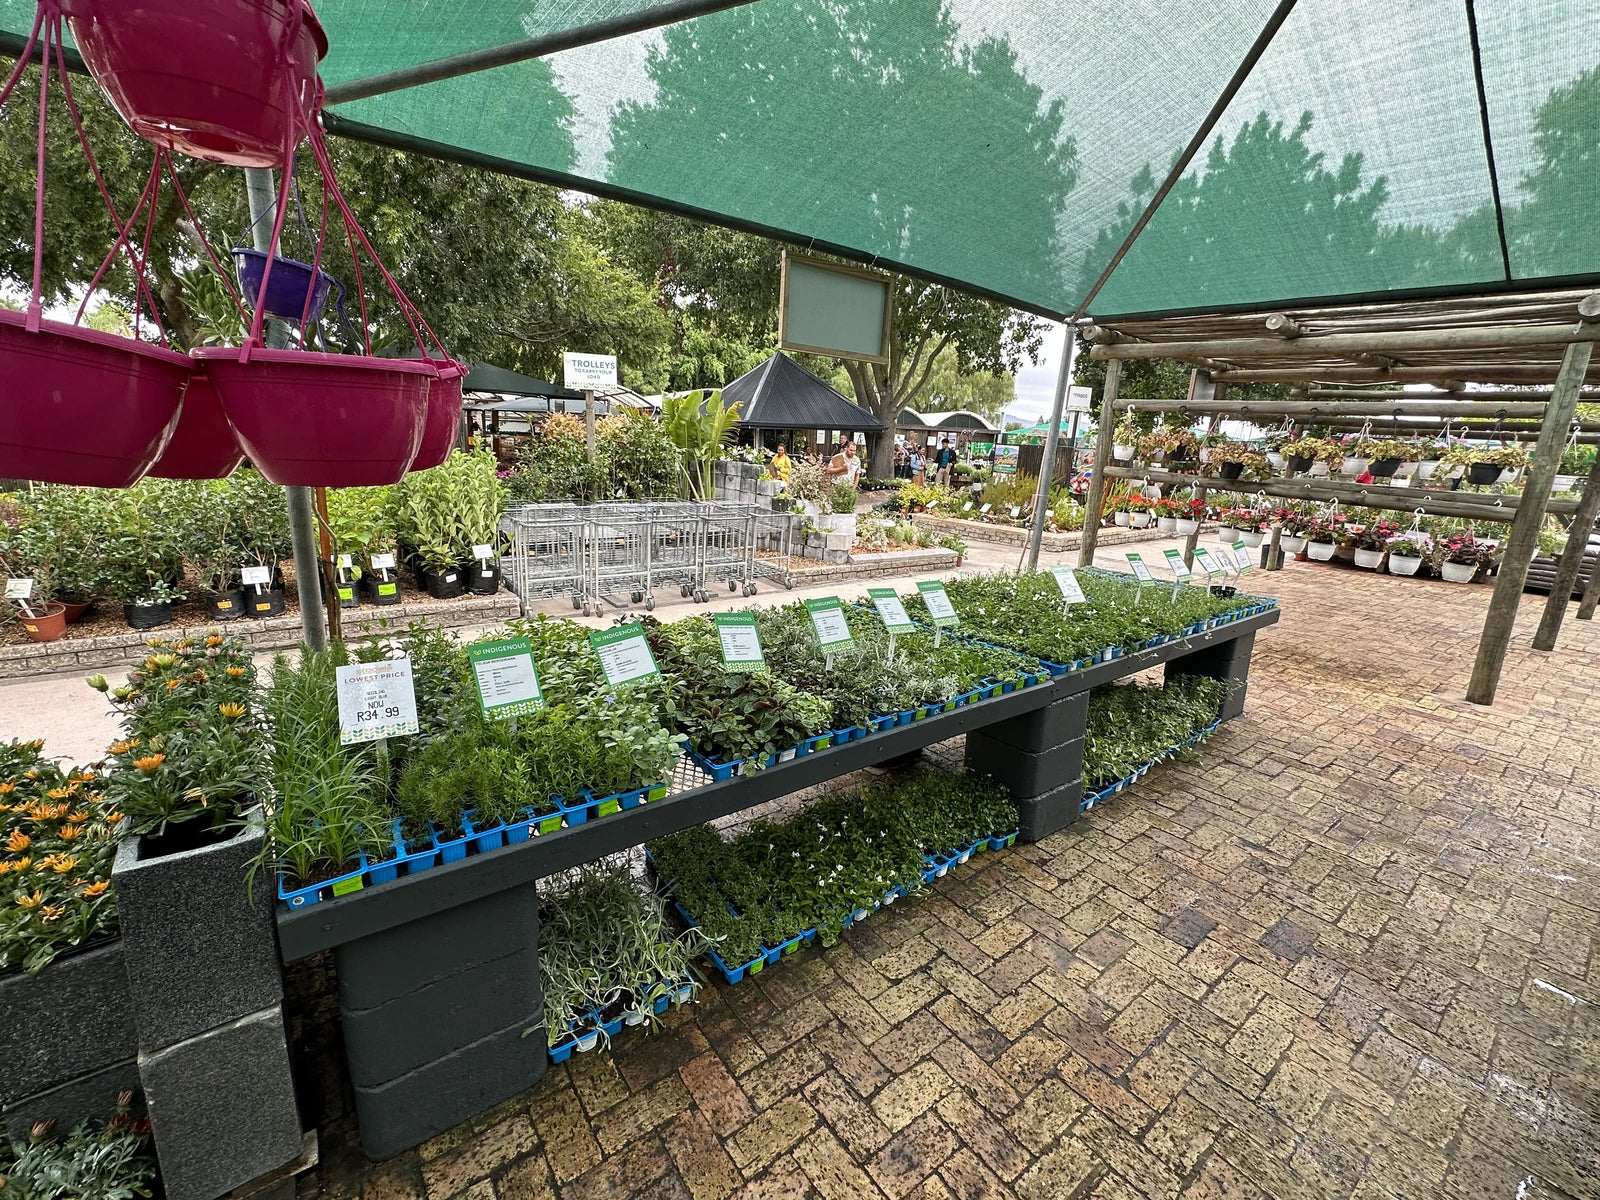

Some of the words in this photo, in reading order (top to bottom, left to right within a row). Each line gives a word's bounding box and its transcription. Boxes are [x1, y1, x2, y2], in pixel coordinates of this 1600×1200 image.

[572, 360, 615, 369] TROLLEYS
[601, 626, 640, 641] INDIGENOUS
[482, 642, 527, 655] INDIGENOUS
[344, 675, 378, 684] LOWEST
[367, 700, 385, 710] NOW
[356, 706, 400, 722] R34.99
